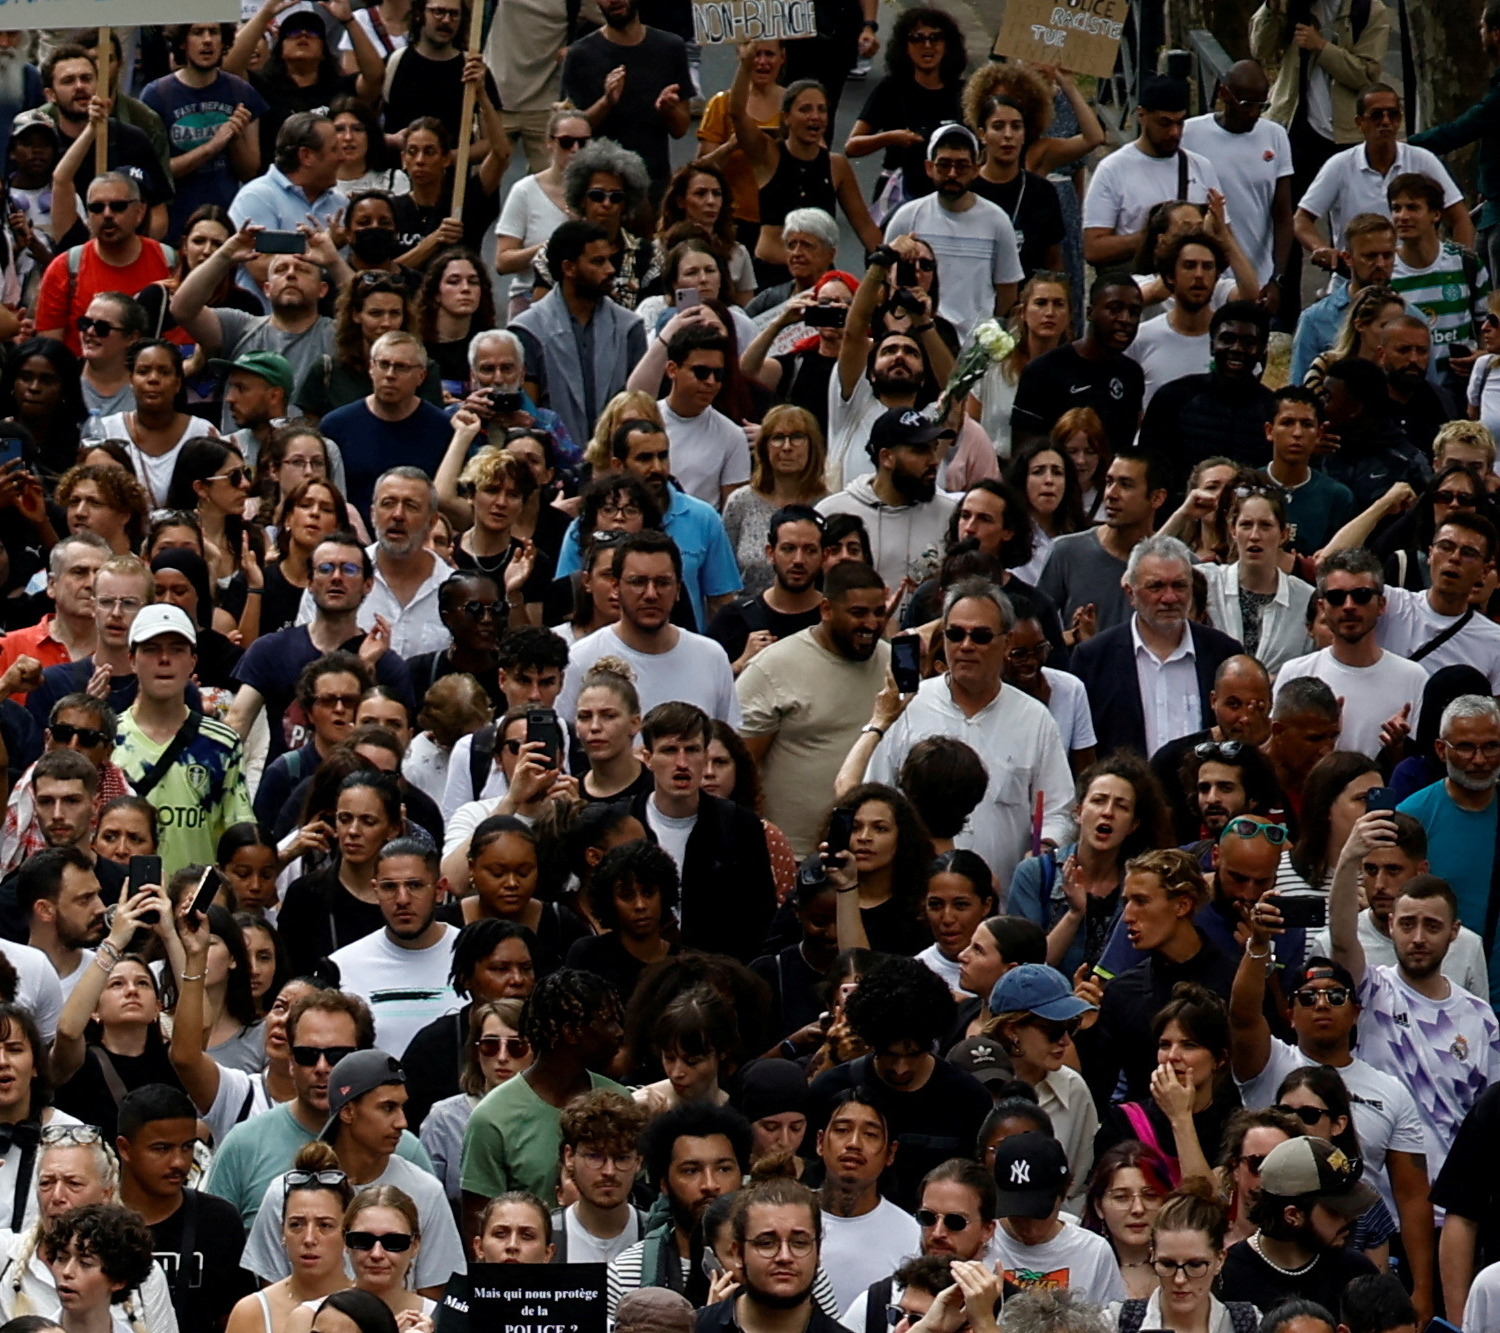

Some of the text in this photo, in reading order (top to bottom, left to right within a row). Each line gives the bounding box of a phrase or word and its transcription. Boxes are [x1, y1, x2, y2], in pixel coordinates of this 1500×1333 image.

[1054, 0, 1116, 19] OLICE
[1050, 6, 1124, 40] RACISTE
[1030, 24, 1067, 47] TUE
[172, 124, 222, 142] GARA
[444, 1293, 470, 1314] Mais
[474, 1287, 599, 1302] Mais qui nous protège
[521, 1305, 548, 1318] de la
